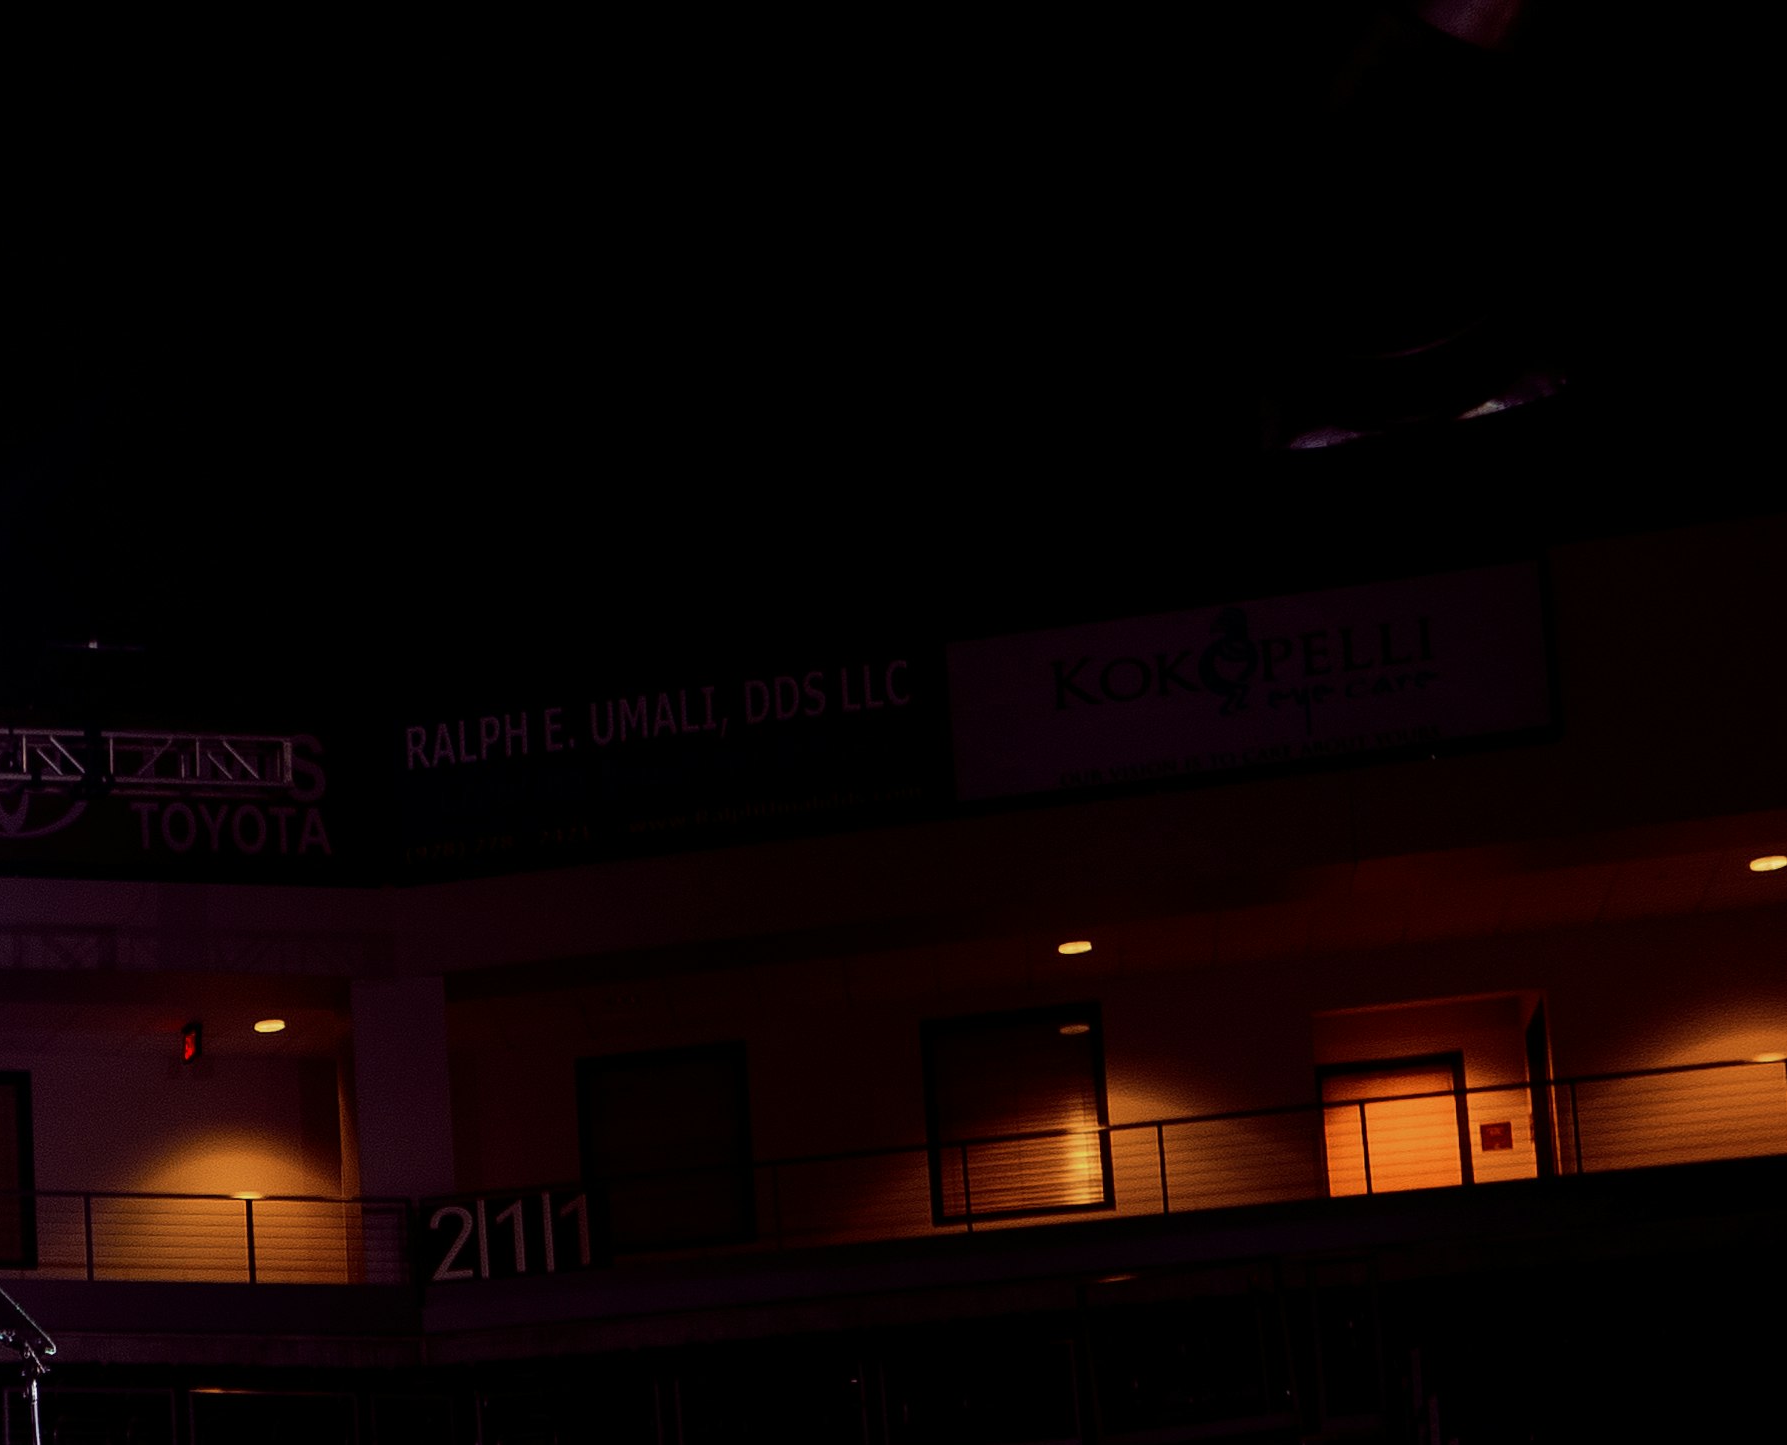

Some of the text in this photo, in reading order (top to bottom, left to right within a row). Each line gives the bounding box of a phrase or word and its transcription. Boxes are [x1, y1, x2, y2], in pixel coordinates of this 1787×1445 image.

[405, 659, 912, 770] RALPH E. UMALI, DDS LLC
[1269, 671, 1439, 736] eye care
[1061, 769, 1102, 787] OUR
[1109, 760, 1177, 782] VISION
[1185, 757, 1202, 771] IS
[1210, 752, 1237, 769] TO
[1242, 744, 1292, 764] CARE
[1301, 735, 1365, 757] ABOUT
[129, 801, 334, 856] TOYOTA
